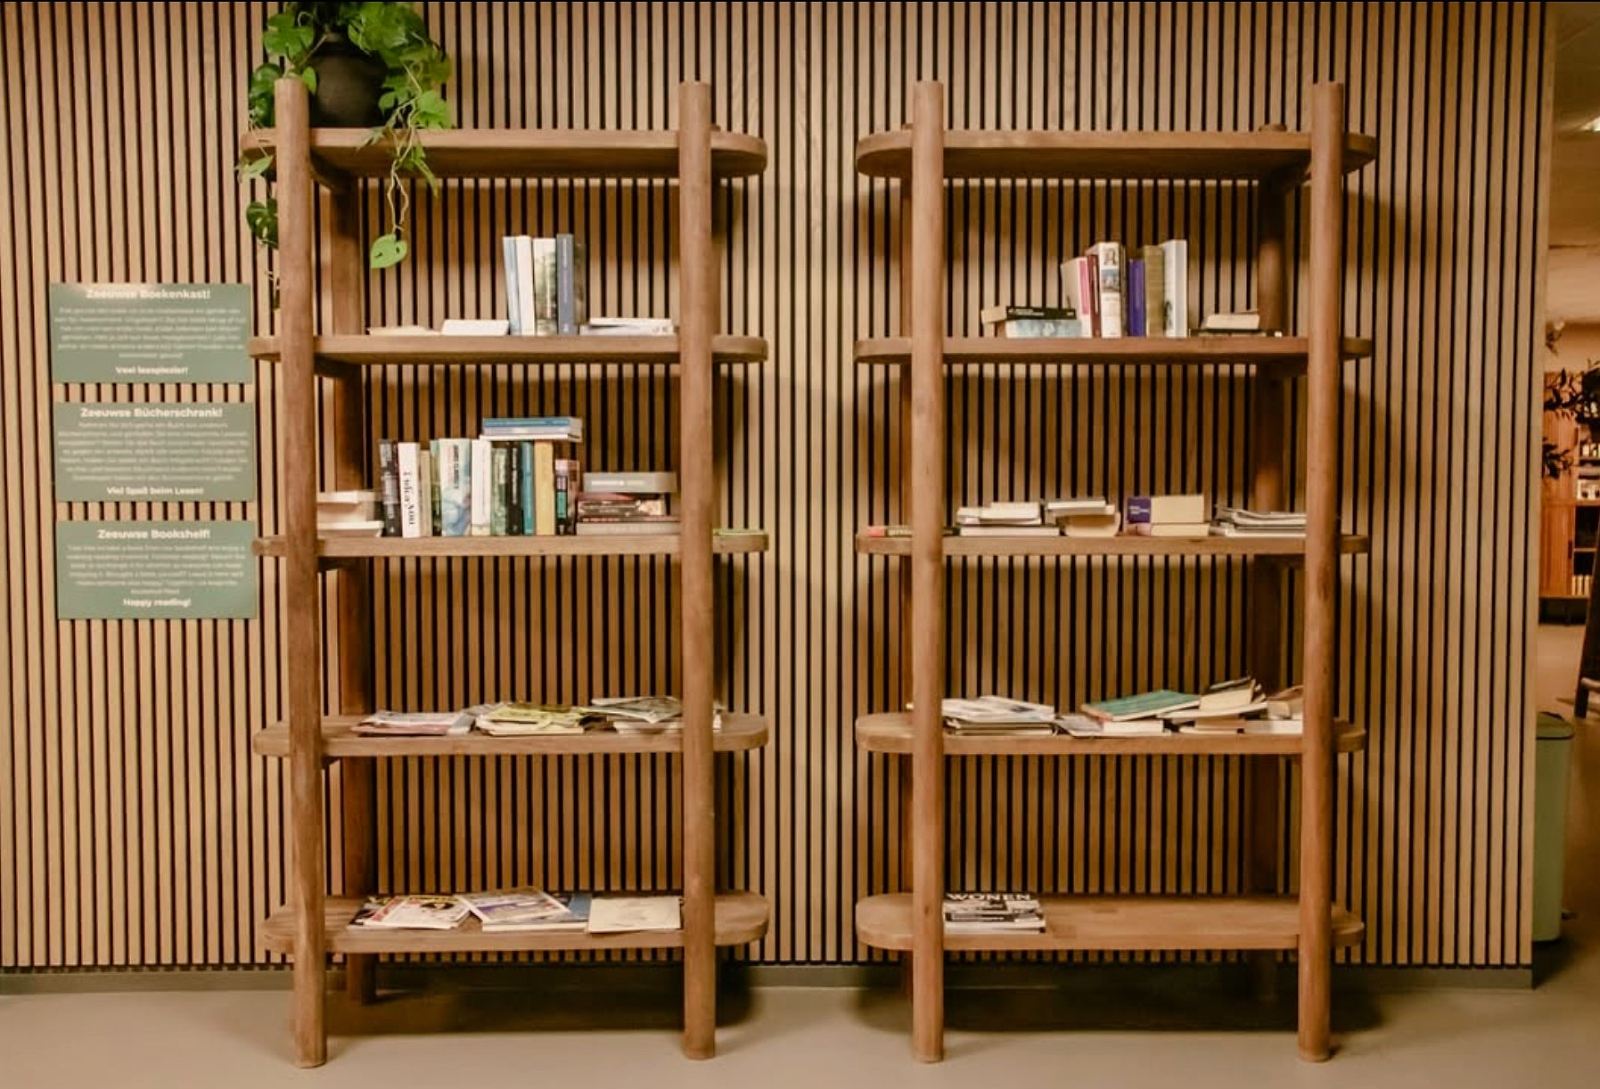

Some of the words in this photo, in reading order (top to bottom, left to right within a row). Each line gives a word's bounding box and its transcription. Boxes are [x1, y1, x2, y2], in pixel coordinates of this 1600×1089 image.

[140, 289, 211, 299] Boekenkast!
[80, 407, 132, 418] Zeeuwse
[133, 407, 224, 418] Bücherschrank!
[106, 486, 124, 496] Viel
[97, 529, 148, 539] Zeeuwse
[150, 528, 211, 539] Bookshelf!
[122, 598, 152, 609] Happy
[153, 597, 192, 609] reading!
